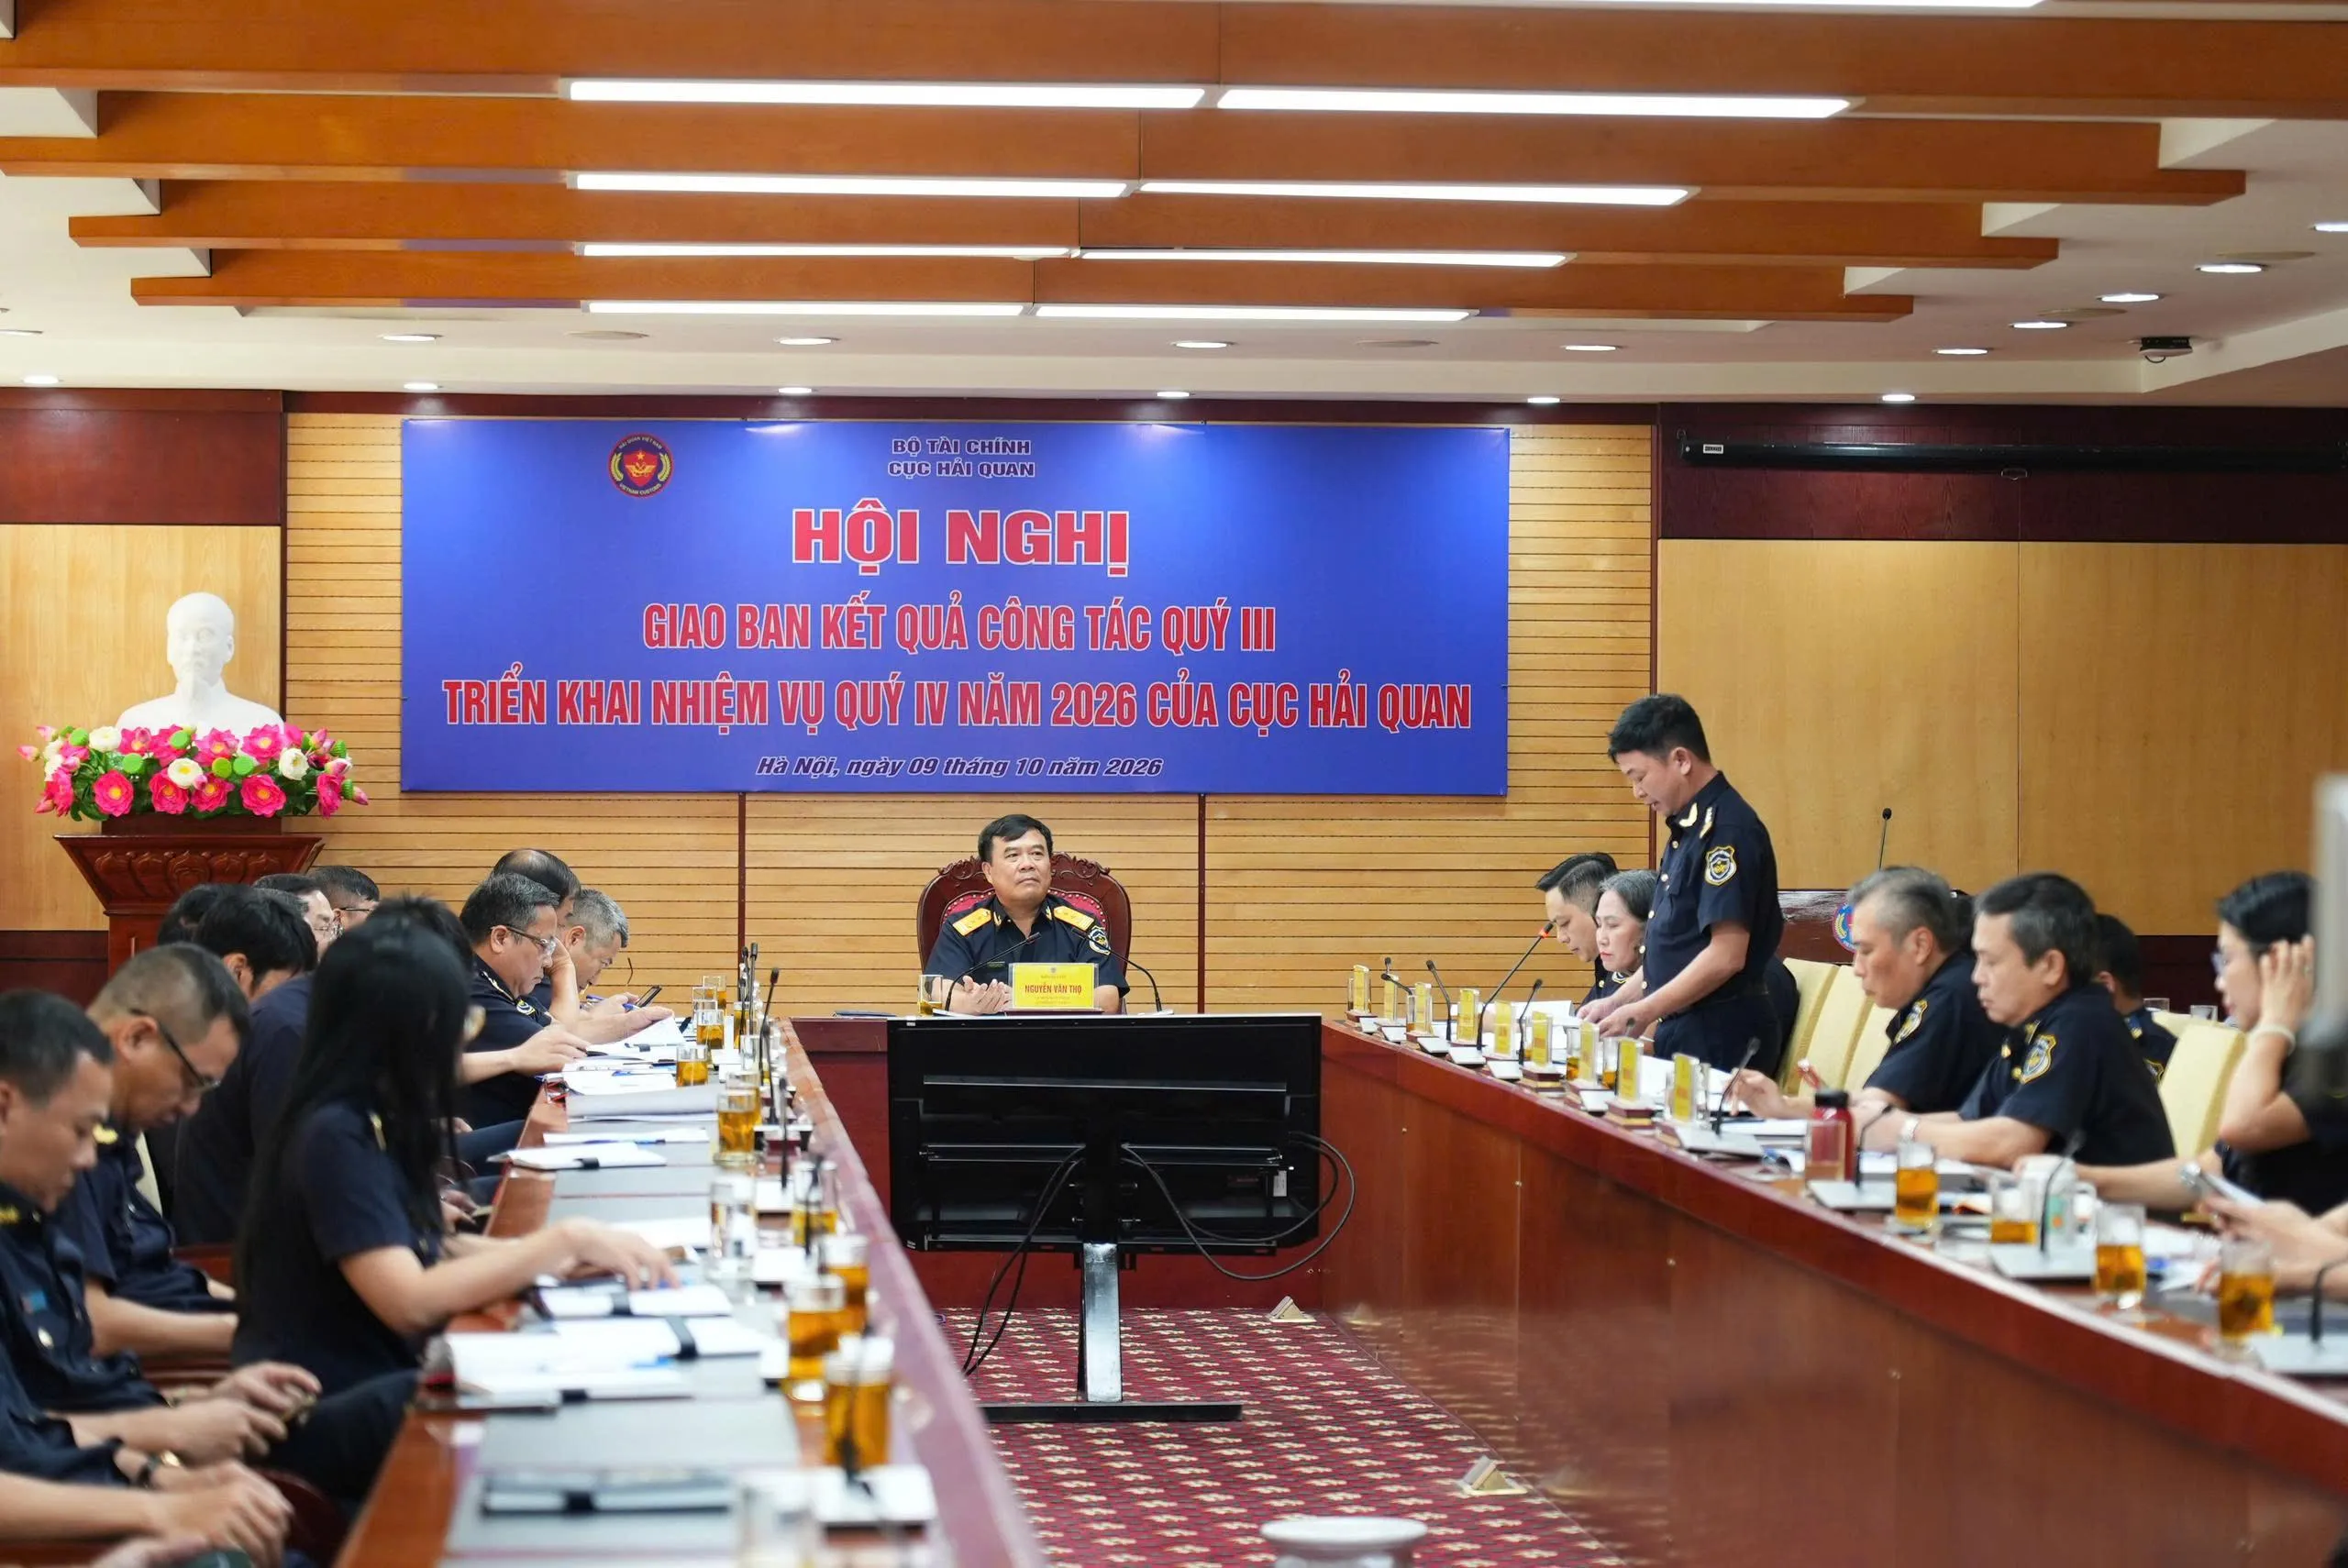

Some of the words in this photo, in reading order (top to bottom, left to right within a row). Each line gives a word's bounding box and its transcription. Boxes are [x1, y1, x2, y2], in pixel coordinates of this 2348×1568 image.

[892, 436, 921, 457] BỘ
[926, 436, 959, 455] TÀI
[966, 437, 1031, 456] CHÍNH
[888, 461, 931, 480] CỤC
[936, 457, 972, 477] HẢI
[979, 461, 1036, 479] QUAN
[792, 498, 920, 576] HỘI
[946, 510, 1129, 578] NGHỊ
[643, 603, 726, 649] GIAO
[737, 604, 811, 649] BAN
[821, 590, 887, 649] KẾT
[896, 590, 969, 655] QUẢ
[978, 596, 1075, 651] CÔNG
[1084, 596, 1151, 651] TÁC
[1161, 597, 1231, 657] QUÝ
[1241, 607, 1276, 652] III
[442, 661, 547, 725] TRIỂN
[557, 679, 641, 725] KHAI
[651, 671, 769, 735] NHIỆM
[778, 680, 825, 735] VỤ
[835, 671, 904, 731] QUÝ
[914, 681, 948, 725] IV
[958, 672, 1040, 726] NĂM
[1050, 681, 1137, 727] 2026
[1146, 668, 1218, 727] CỦA
[1228, 682, 1299, 737] CỤC
[1309, 668, 1368, 728] HẢI
[1378, 684, 1471, 734] QUAN
[756, 756, 788, 775] Hà
[792, 756, 838, 778] Nội,
[846, 757, 903, 778] ngày
[907, 757, 938, 776] 09
[942, 756, 1010, 778] tháng
[1015, 758, 1044, 776] 10
[1047, 757, 1100, 777] năm
[1103, 758, 1164, 777] 2026
[1054, 983, 1068, 993] VĂN
[1069, 984, 1081, 995] THỌ
